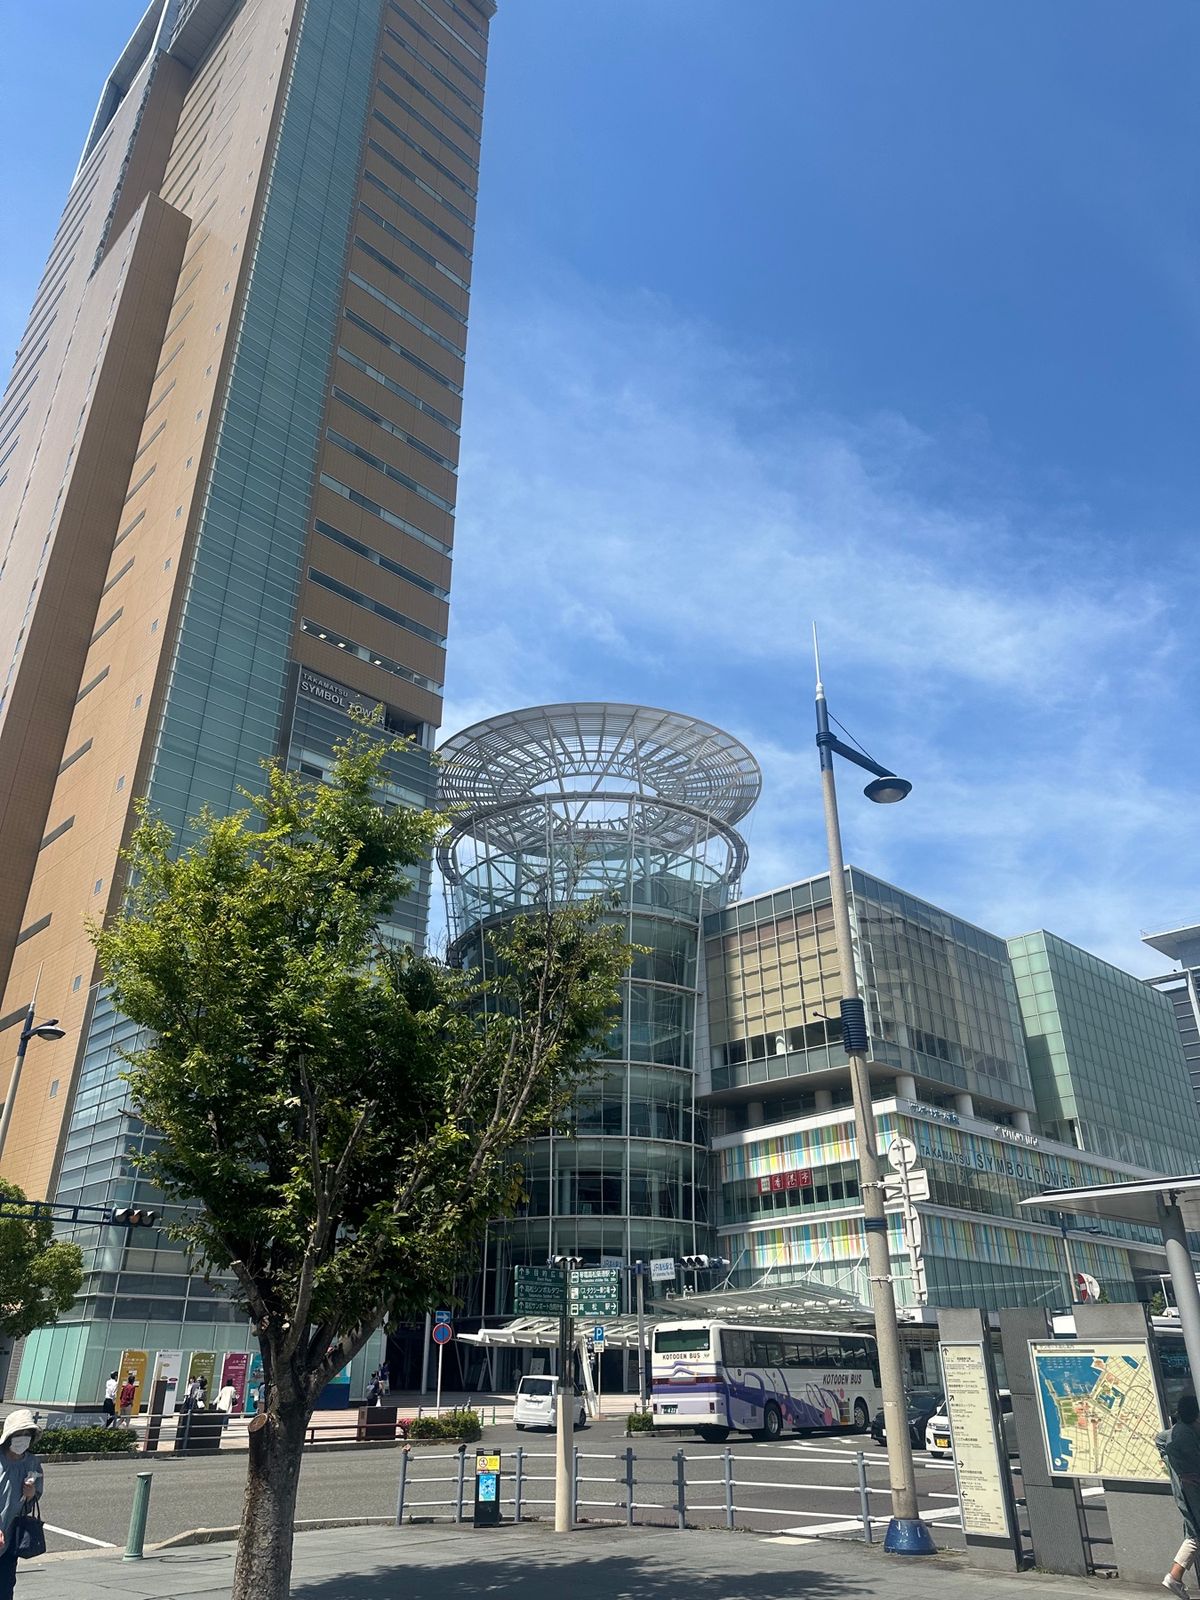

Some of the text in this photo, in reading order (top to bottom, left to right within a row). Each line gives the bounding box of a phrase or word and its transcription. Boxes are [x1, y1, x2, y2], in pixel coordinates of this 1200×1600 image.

[301, 681, 346, 708] SYMBOL
[302, 672, 349, 698] TAKAMATSU
[920, 1144, 1076, 1189] TAKAMATSU SYMBOL TOWER
[596, 1327, 603, 1340] P
[662, 1352, 701, 1361] KOTODEN BUS
[822, 1373, 862, 1385] KOTODEN BUS
